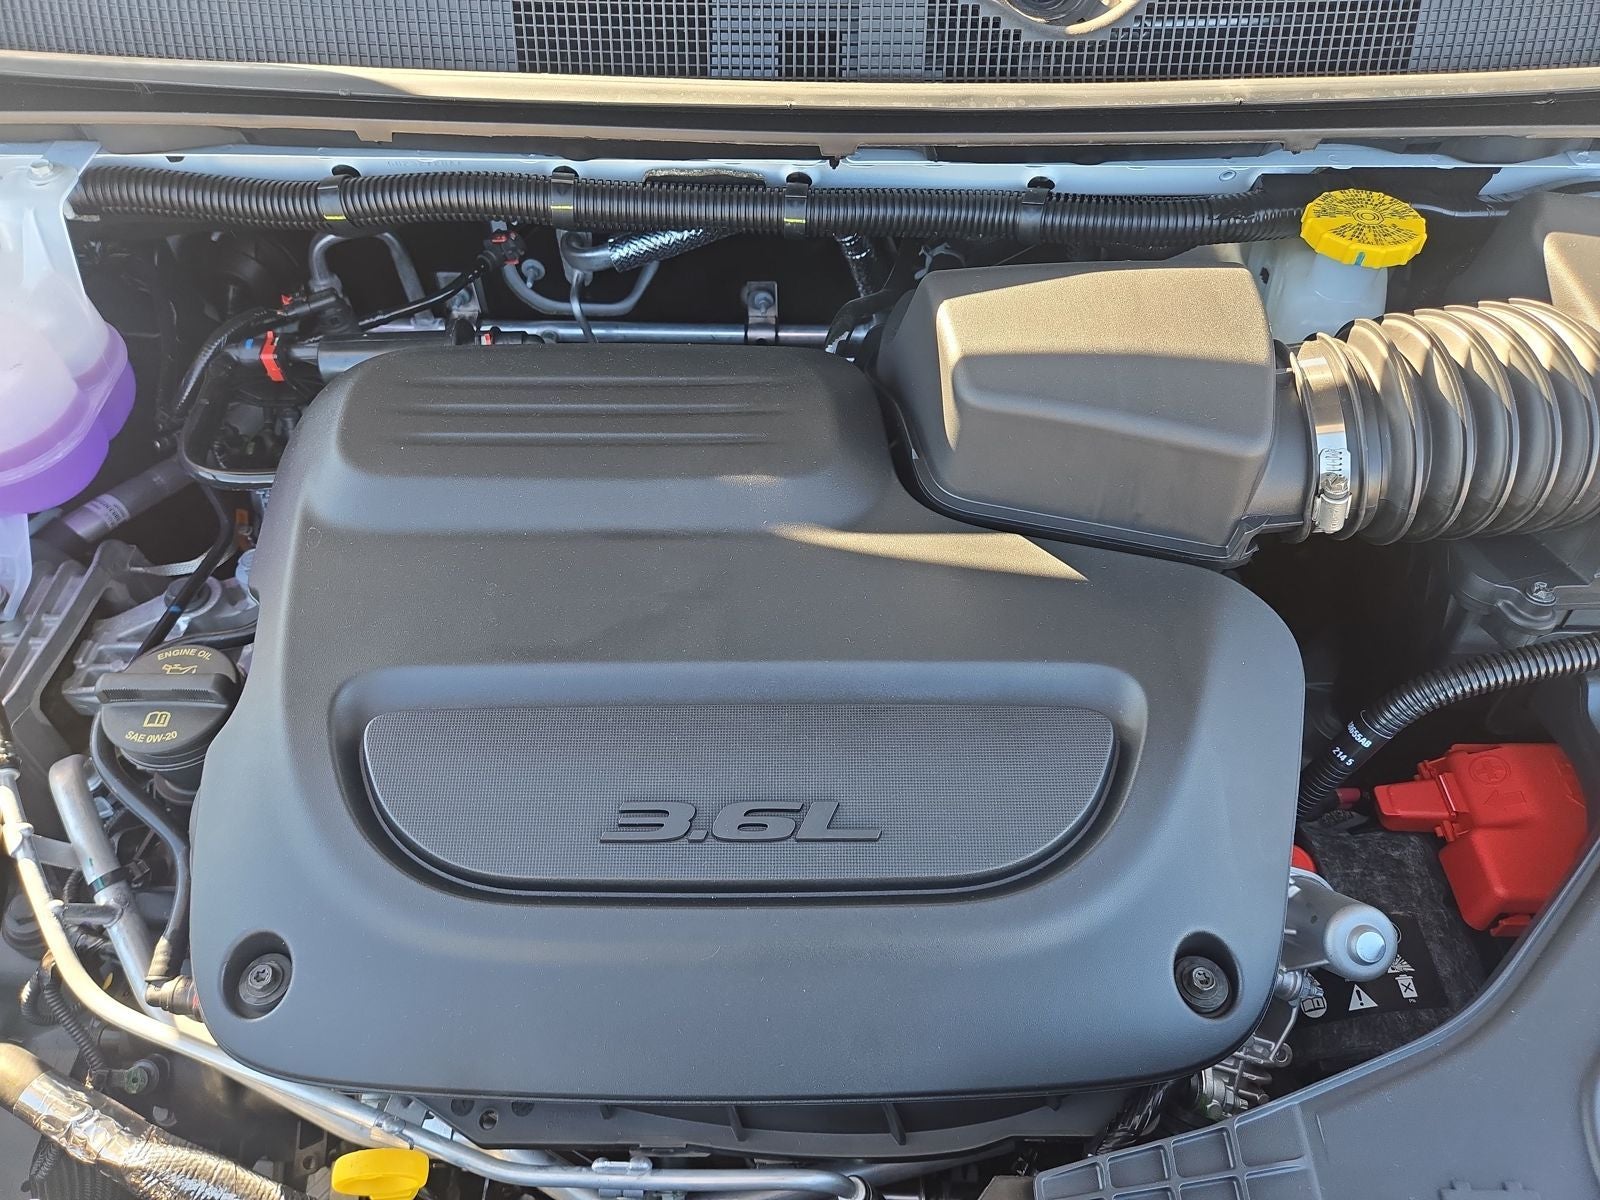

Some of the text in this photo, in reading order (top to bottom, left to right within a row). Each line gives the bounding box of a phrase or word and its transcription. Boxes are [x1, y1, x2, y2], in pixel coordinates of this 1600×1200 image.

[157, 648, 212, 660] ENGINE OIL
[125, 731, 178, 743] SAE 0W-20
[1332, 746, 1347, 761] 214
[600, 801, 882, 843] 3.6L
